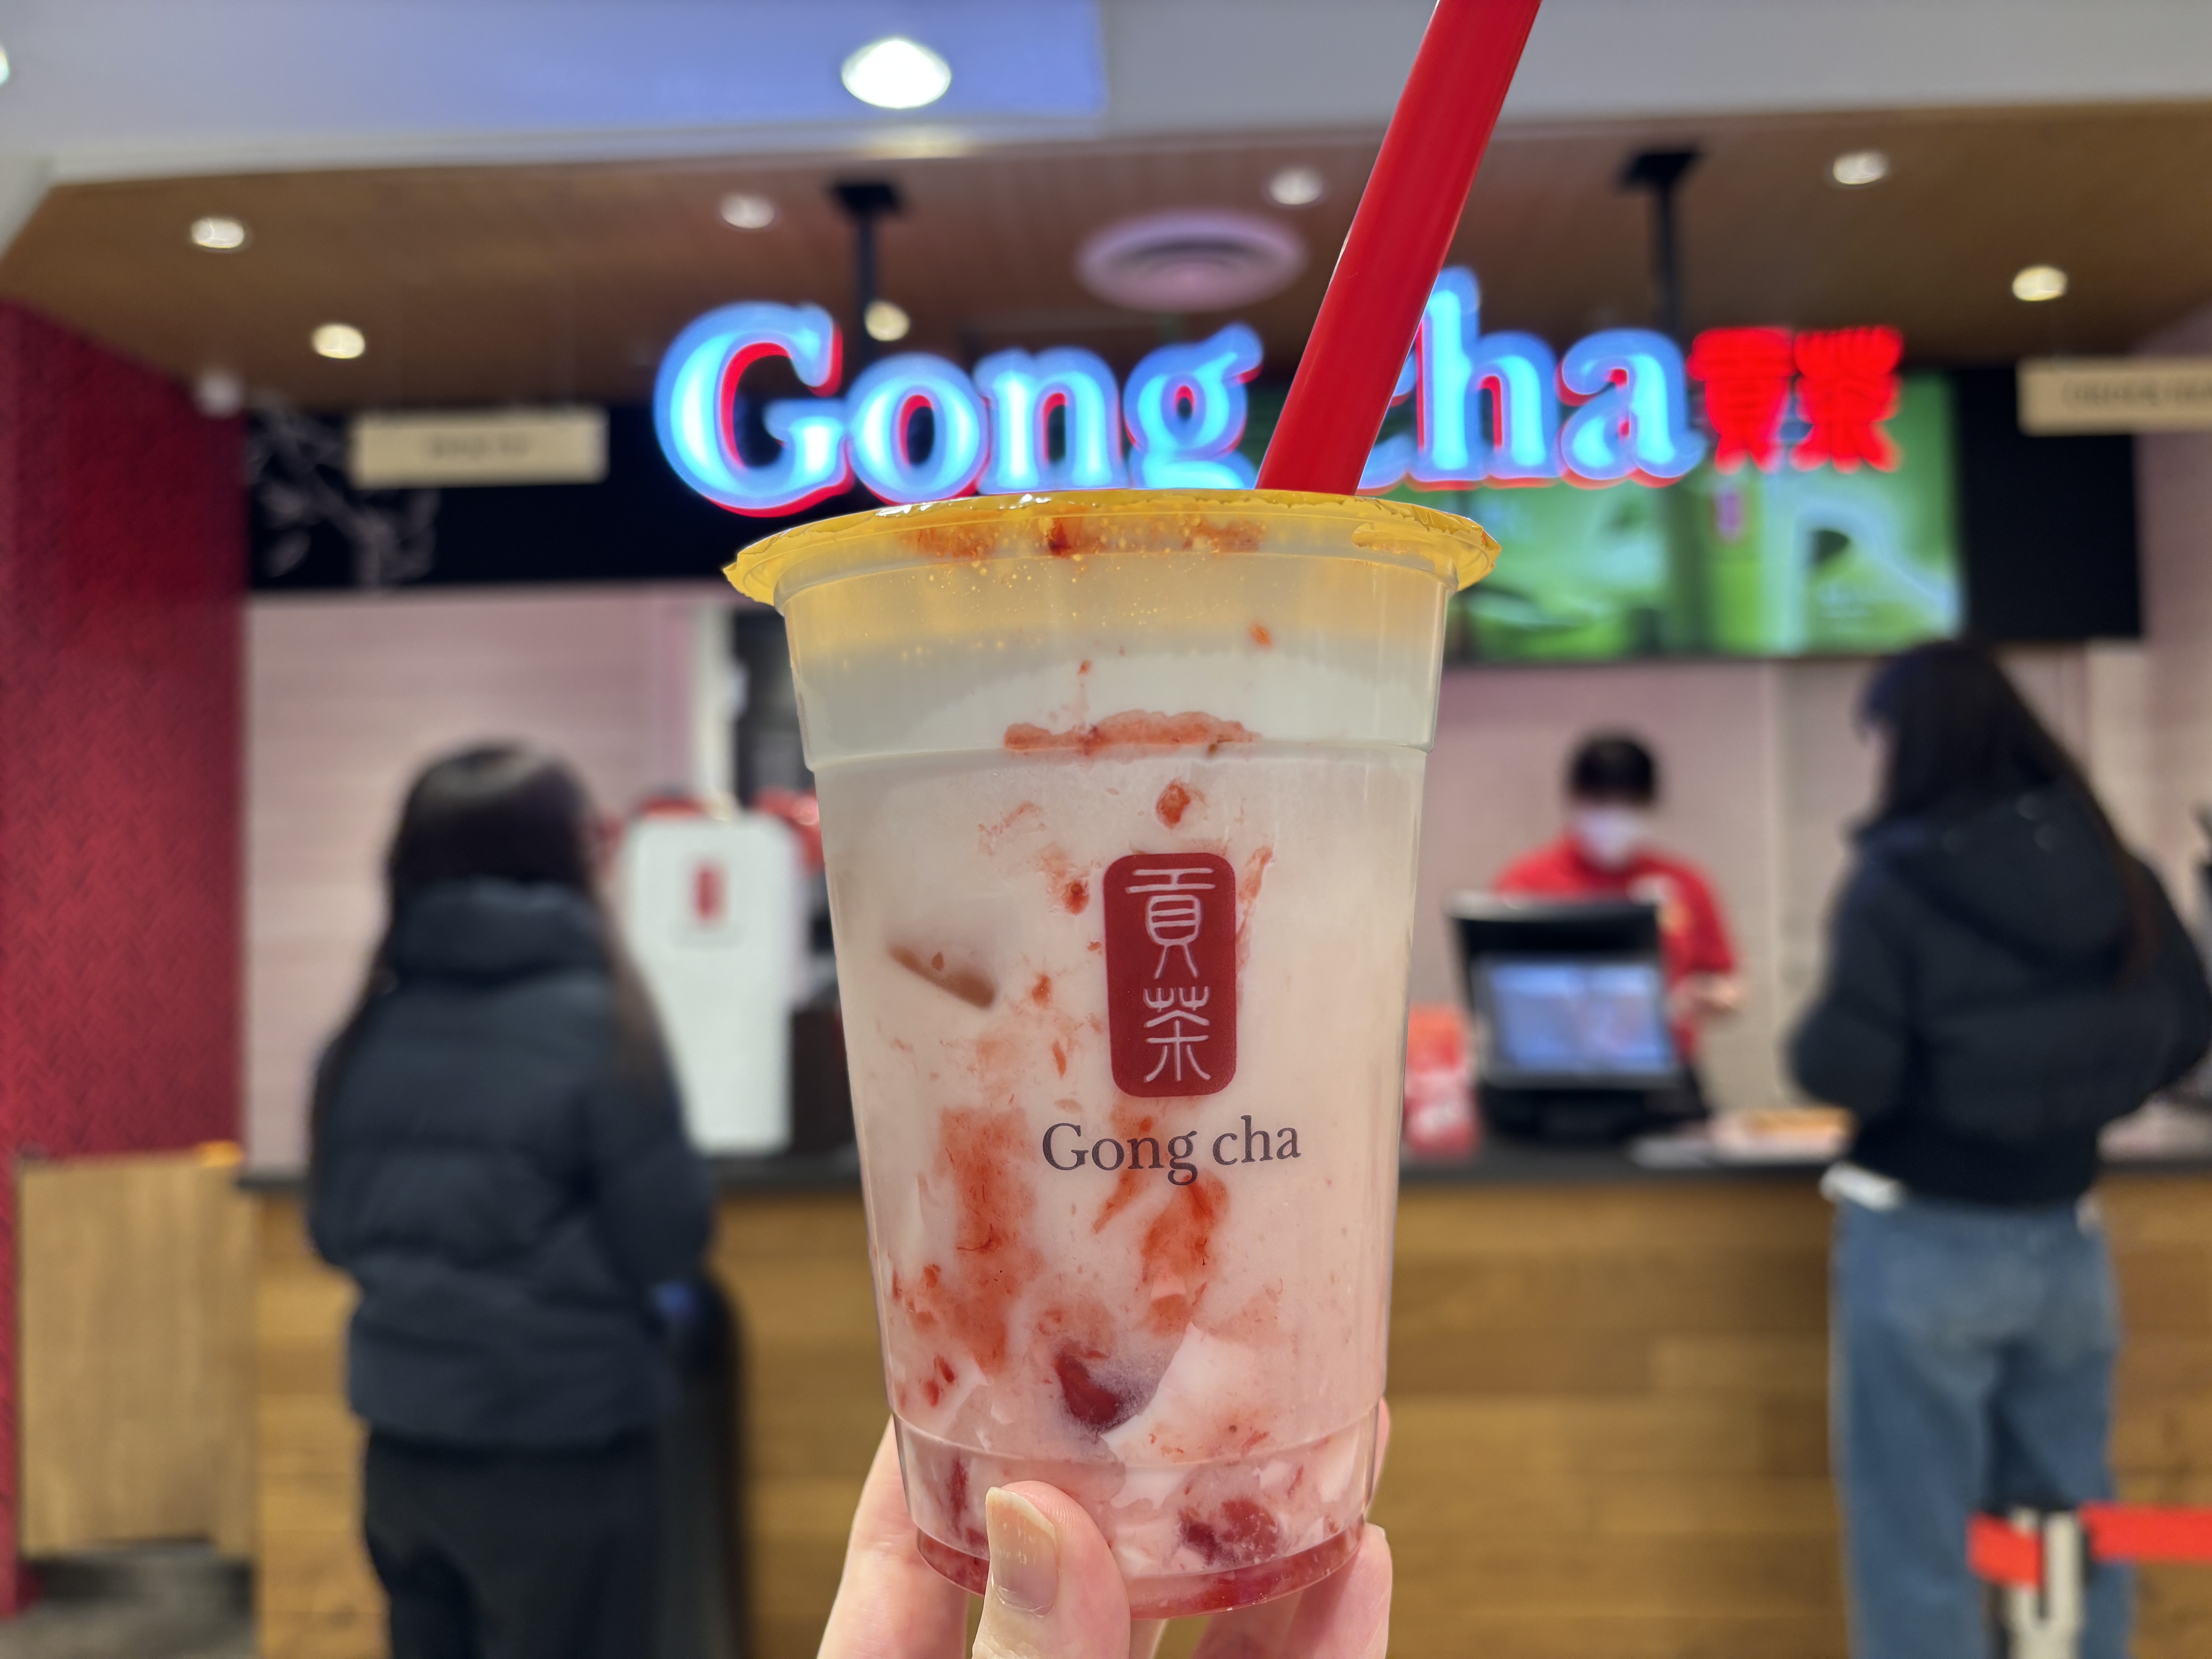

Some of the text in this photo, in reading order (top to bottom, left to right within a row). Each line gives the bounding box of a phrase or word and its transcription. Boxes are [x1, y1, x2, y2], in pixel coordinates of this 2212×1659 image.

[654, 266, 1706, 517] Gong ha
[1125, 867, 1216, 1082] 貢茶
[1042, 1115, 1302, 1186] Gong cha
